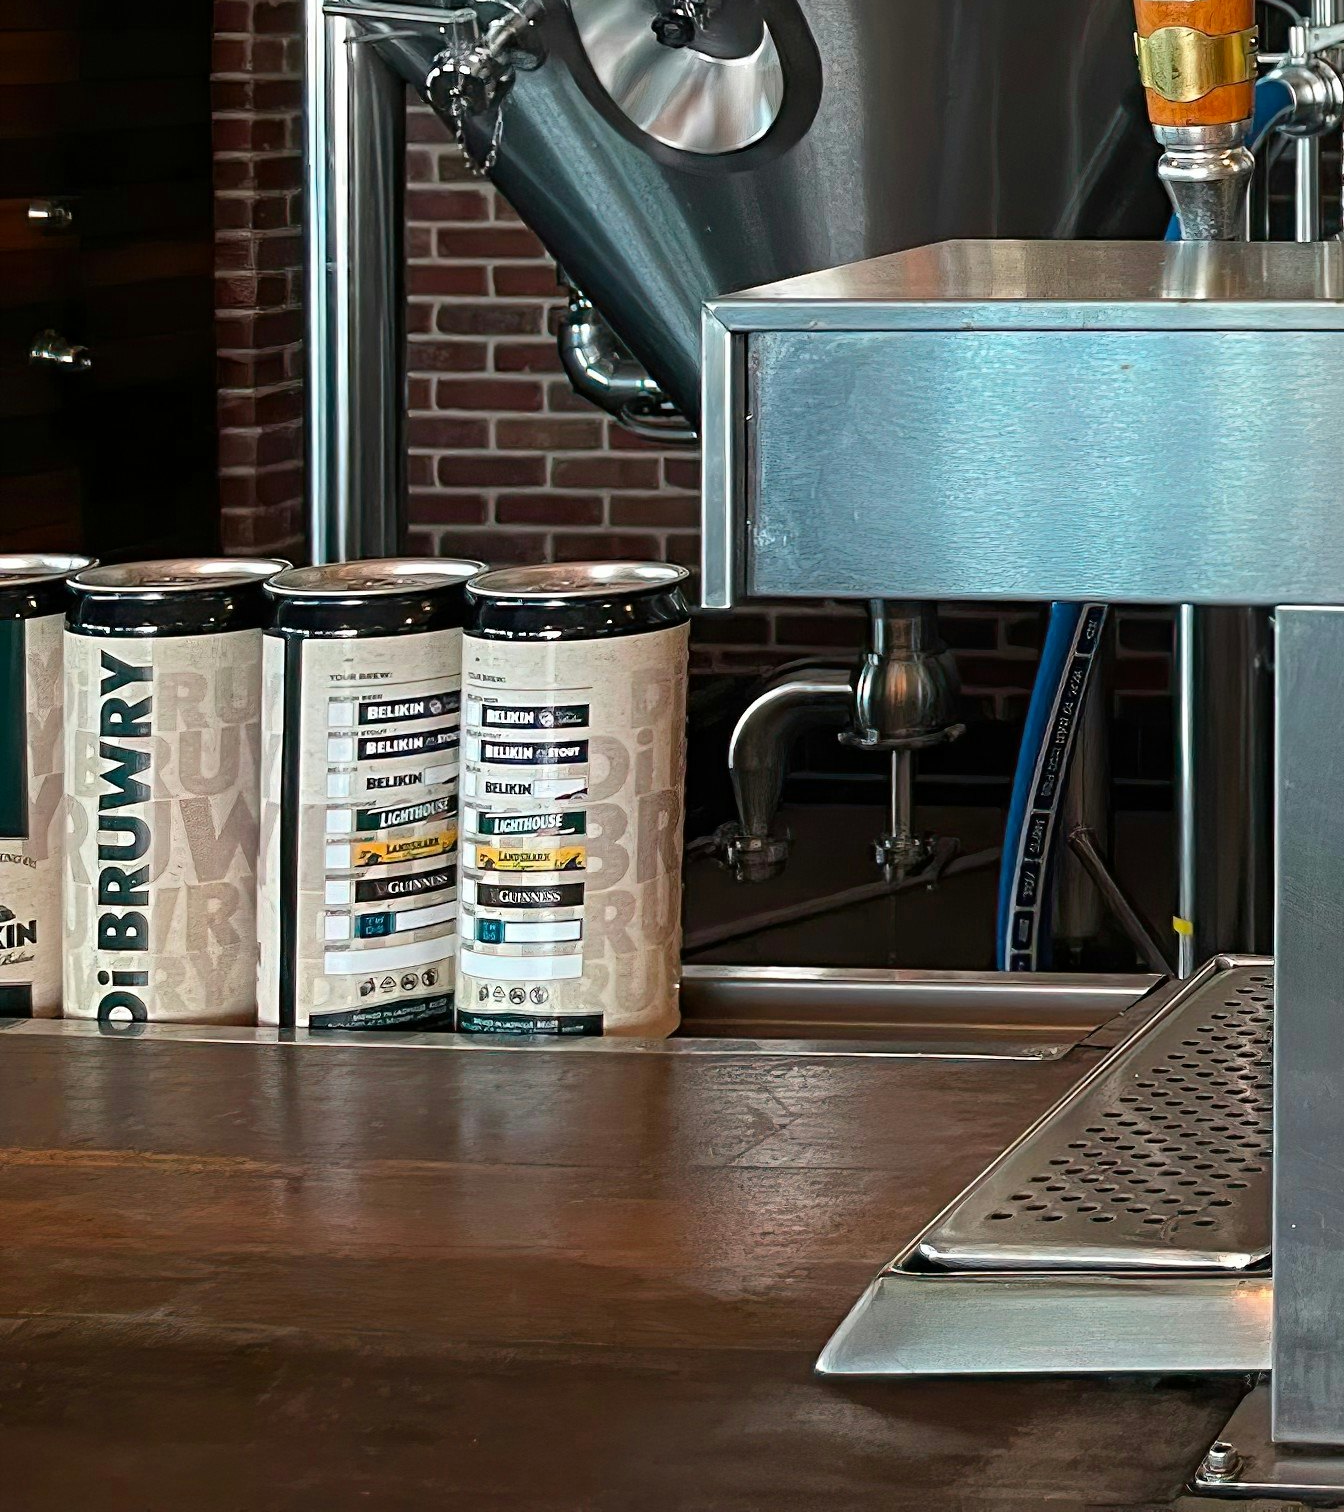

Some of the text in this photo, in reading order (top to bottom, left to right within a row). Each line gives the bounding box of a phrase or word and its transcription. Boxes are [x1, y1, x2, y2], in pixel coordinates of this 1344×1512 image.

[329, 673, 357, 681] YOUR
[367, 702, 425, 720] BELIKIN
[486, 708, 535, 724] BELIKIN
[365, 737, 424, 755] BELIKIN
[485, 744, 580, 760] BELIKIN STOUT
[366, 771, 423, 791] BELIKIN
[485, 781, 532, 796] BELIKIN
[98, 649, 153, 951] BRUWRY
[380, 797, 449, 828] LIGHTHOUSE
[494, 813, 564, 834] LIGHTHOUSE
[387, 874, 449, 894] GUINNESS
[499, 890, 561, 904] GUINNESS
